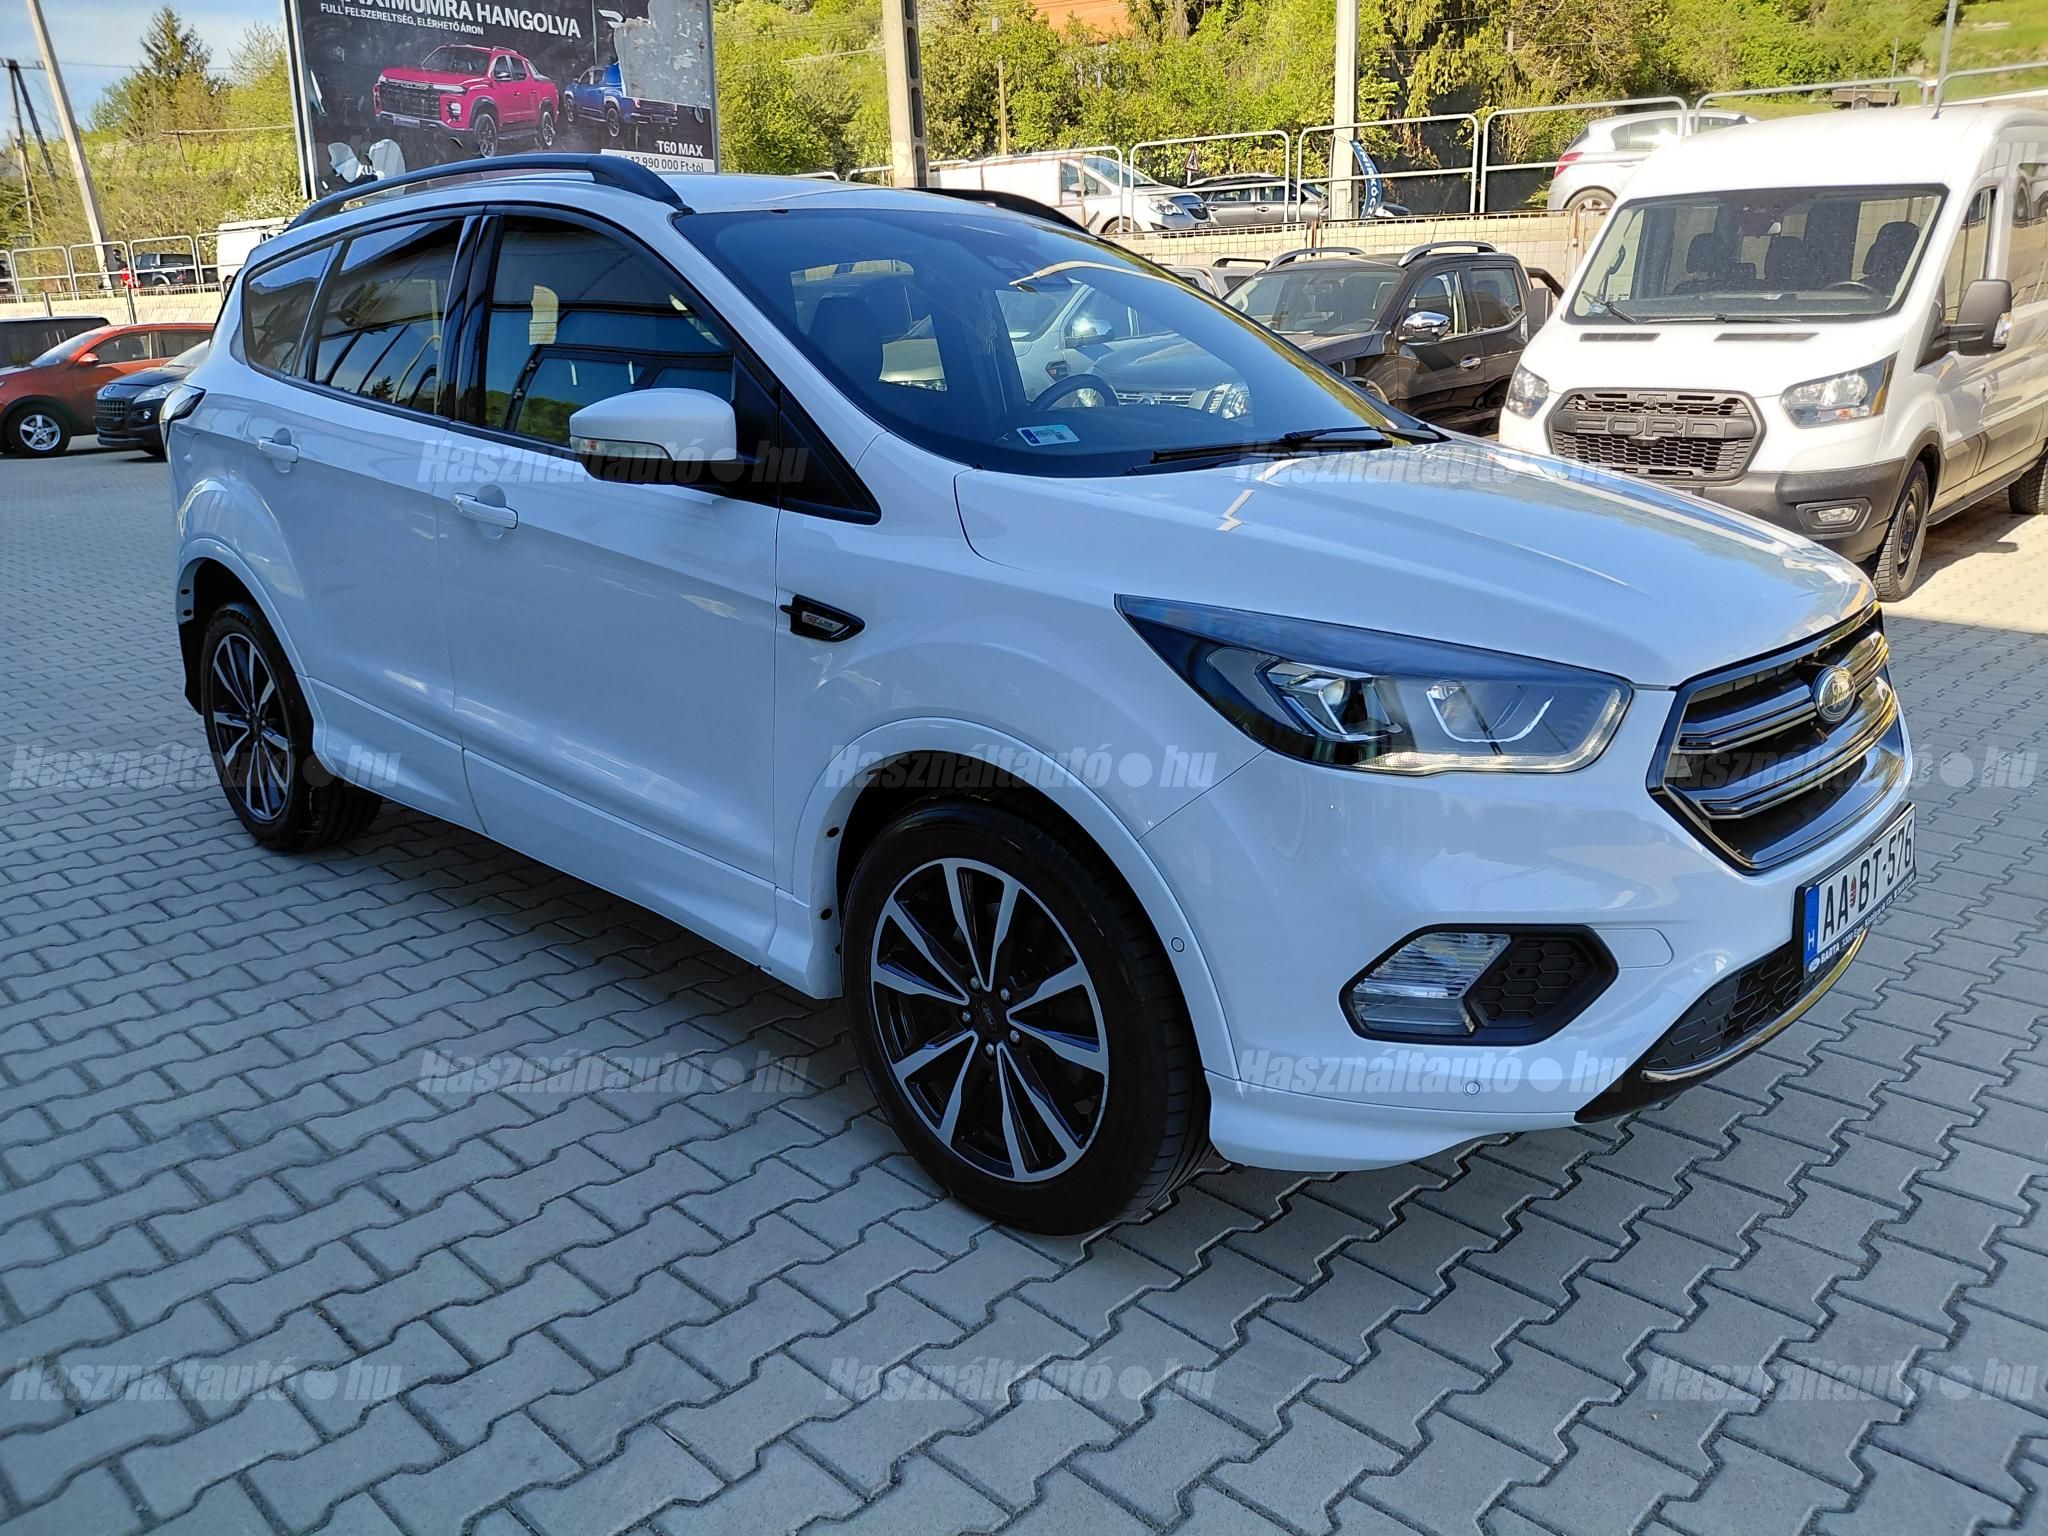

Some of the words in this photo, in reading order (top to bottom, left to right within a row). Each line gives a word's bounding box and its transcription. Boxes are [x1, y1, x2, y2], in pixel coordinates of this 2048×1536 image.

[320, 3, 344, 16] FULL
[345, 6, 416, 27] FELSZERELTSÉG,
[460, 22, 484, 36] ÁRON
[477, 3, 582, 38] HANGOLVA
[656, 140, 677, 155] T60
[678, 142, 704, 157] MAX
[642, 156, 660, 168] 990
[661, 158, 679, 170] 000
[1575, 414, 1728, 439] FORD
[1822, 873, 1849, 942] AA
[1858, 817, 1913, 914] BT-576
[1806, 928, 1816, 952] H
